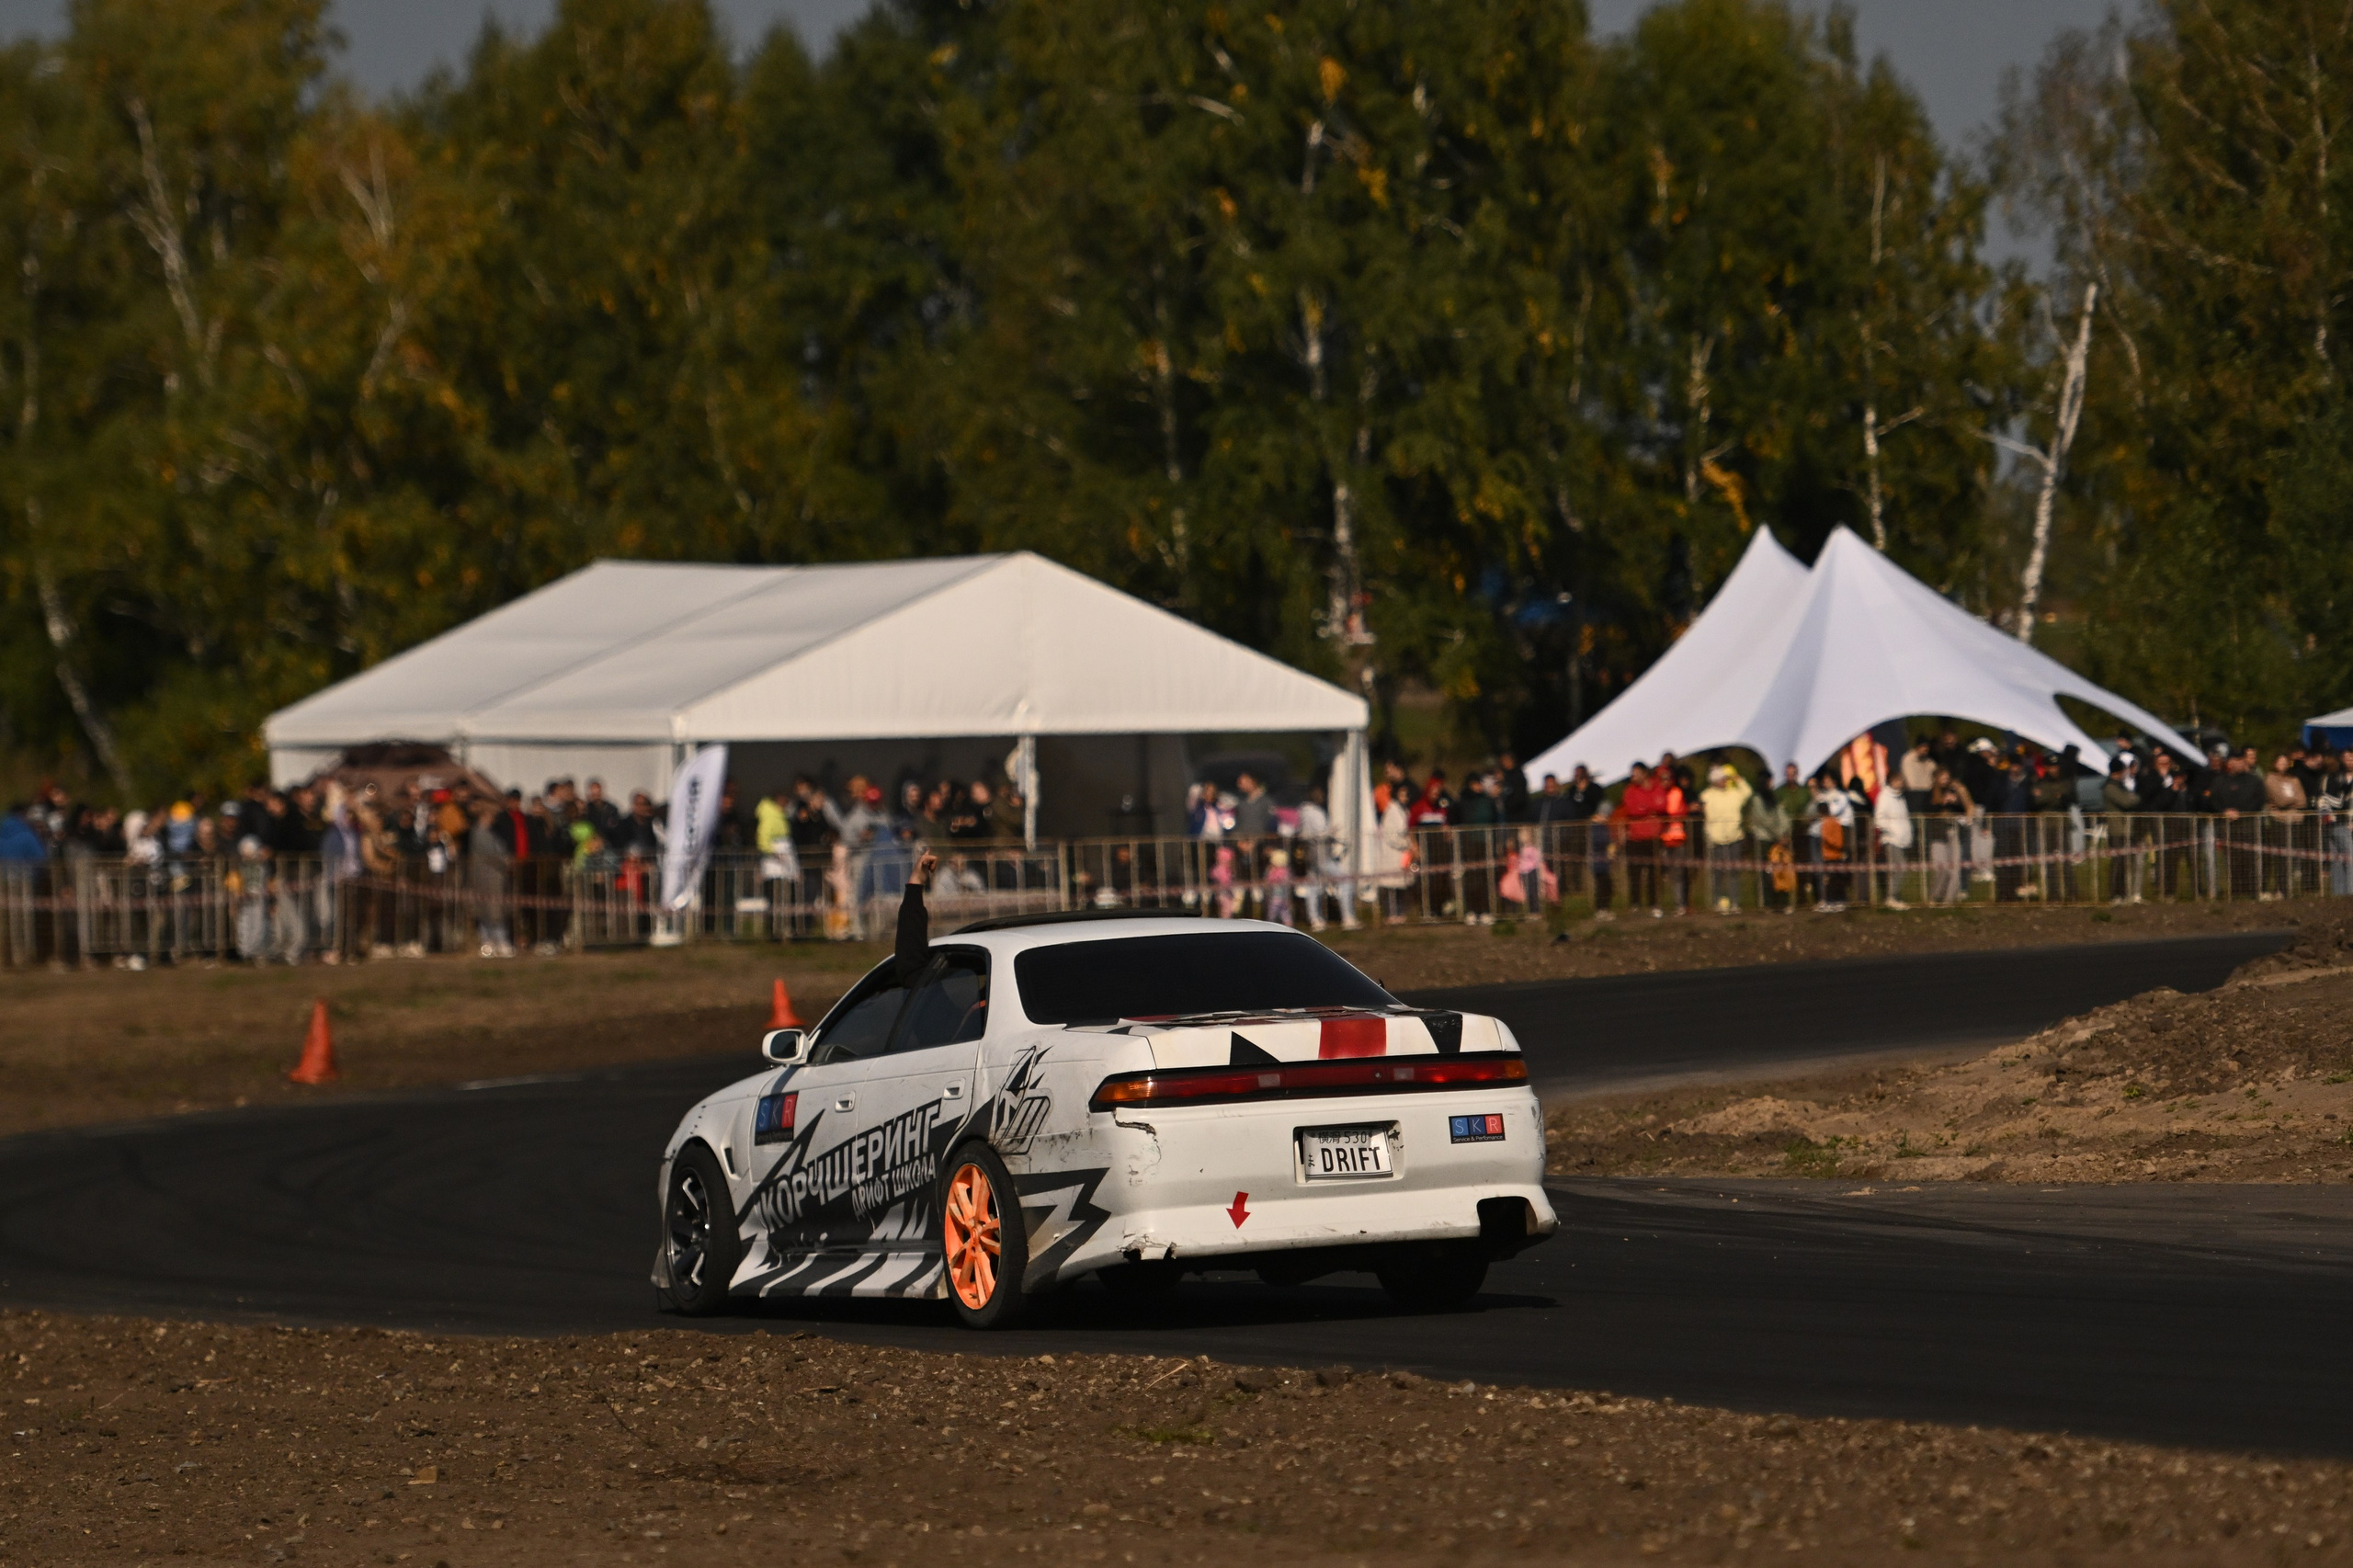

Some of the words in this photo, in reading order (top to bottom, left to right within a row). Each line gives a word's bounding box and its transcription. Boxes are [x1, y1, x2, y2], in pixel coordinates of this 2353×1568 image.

[1455, 1117, 1499, 1134] SKR
[1344, 1131, 1368, 1144] 530
[1321, 1146, 1381, 1172] DRIFT
[851, 1173, 890, 1221] ДРИФТ
[892, 1152, 937, 1198] ШКОЛА
